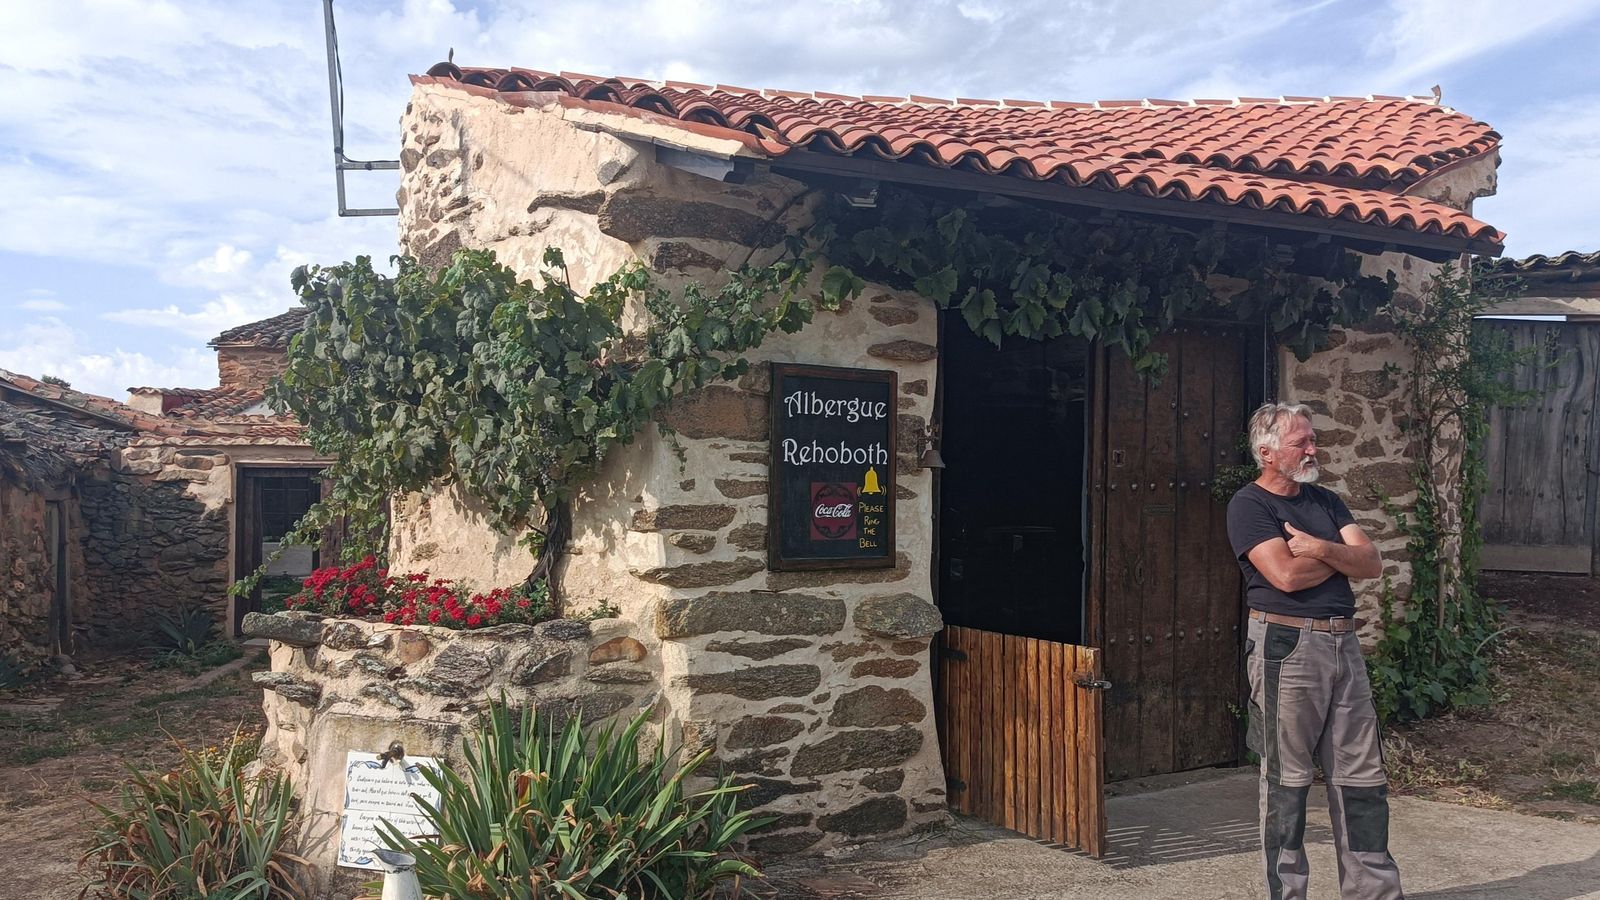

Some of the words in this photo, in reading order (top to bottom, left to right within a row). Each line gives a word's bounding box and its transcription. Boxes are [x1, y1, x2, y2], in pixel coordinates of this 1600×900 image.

[784, 390, 887, 423] Albergue
[782, 438, 888, 466] Rehoboth
[814, 503, 853, 518] Coca-Cola
[864, 515, 880, 526] RING
[863, 527, 876, 536] THE
[860, 537, 878, 549] BELL
